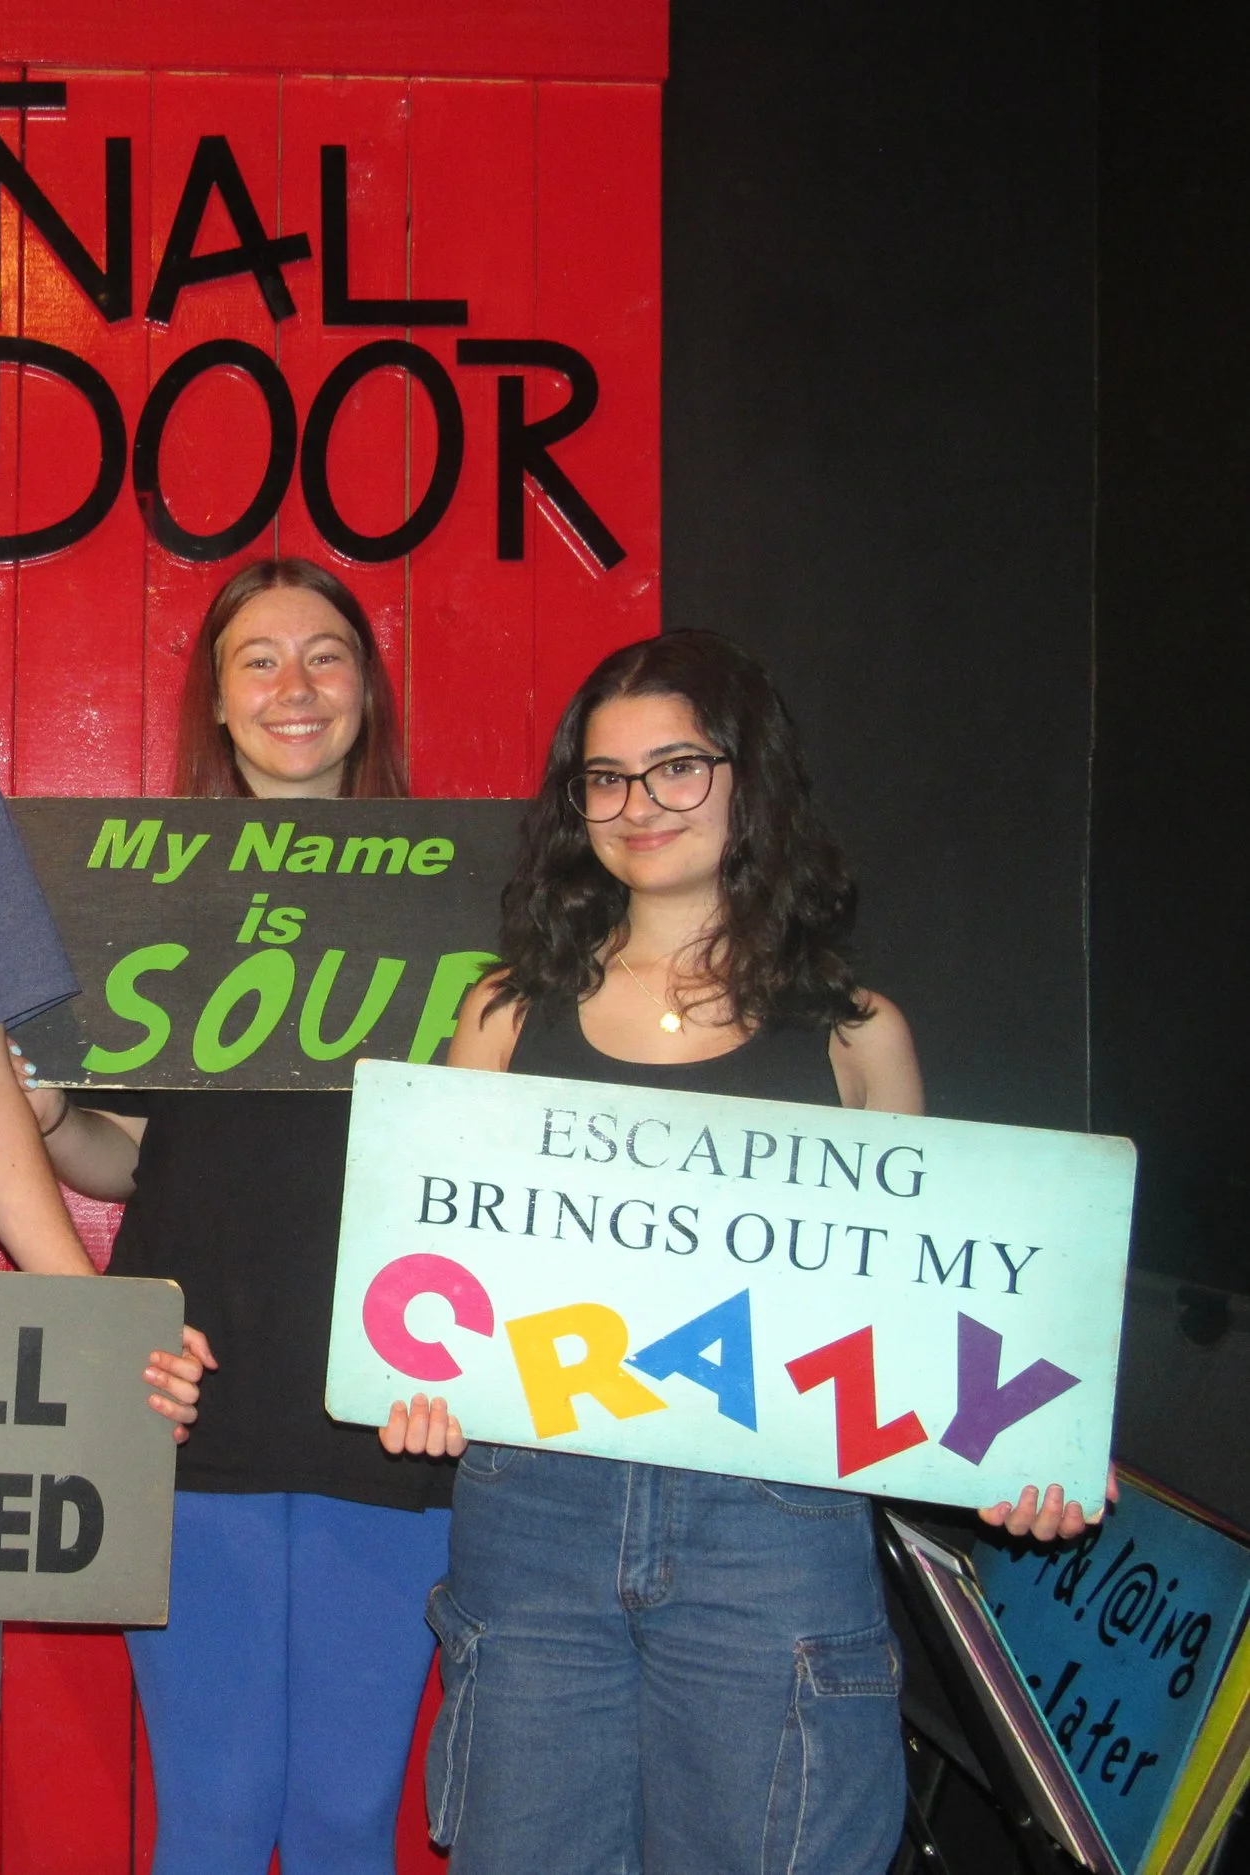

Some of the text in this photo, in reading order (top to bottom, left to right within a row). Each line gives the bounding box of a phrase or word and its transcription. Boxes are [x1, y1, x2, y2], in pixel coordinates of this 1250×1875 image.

[87, 819, 455, 884] My Name
[236, 893, 307, 945] is
[535, 1107, 928, 1199] ESCAPING
[416, 1174, 1044, 1296] BRINGS OUT MY
[361, 1252, 1082, 1479] CRAZY
